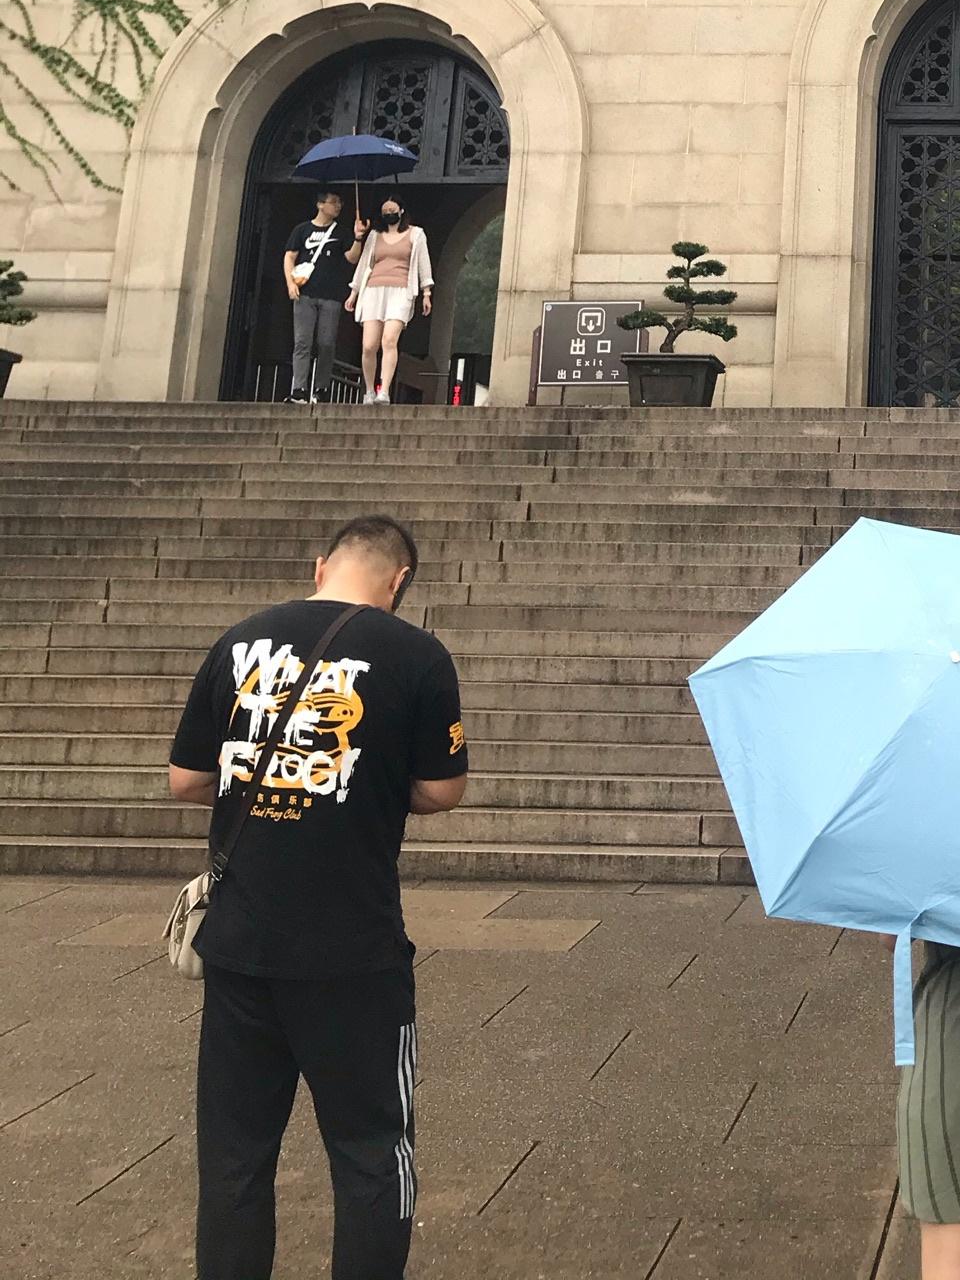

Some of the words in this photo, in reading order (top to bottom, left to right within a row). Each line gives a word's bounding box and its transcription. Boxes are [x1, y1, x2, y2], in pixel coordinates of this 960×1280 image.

[309, 249, 331, 257] AR
[570, 338, 612, 355] 出口
[576, 358, 603, 367] Exit
[557, 368, 582, 380] 出口
[283, 807, 302, 821] Club
